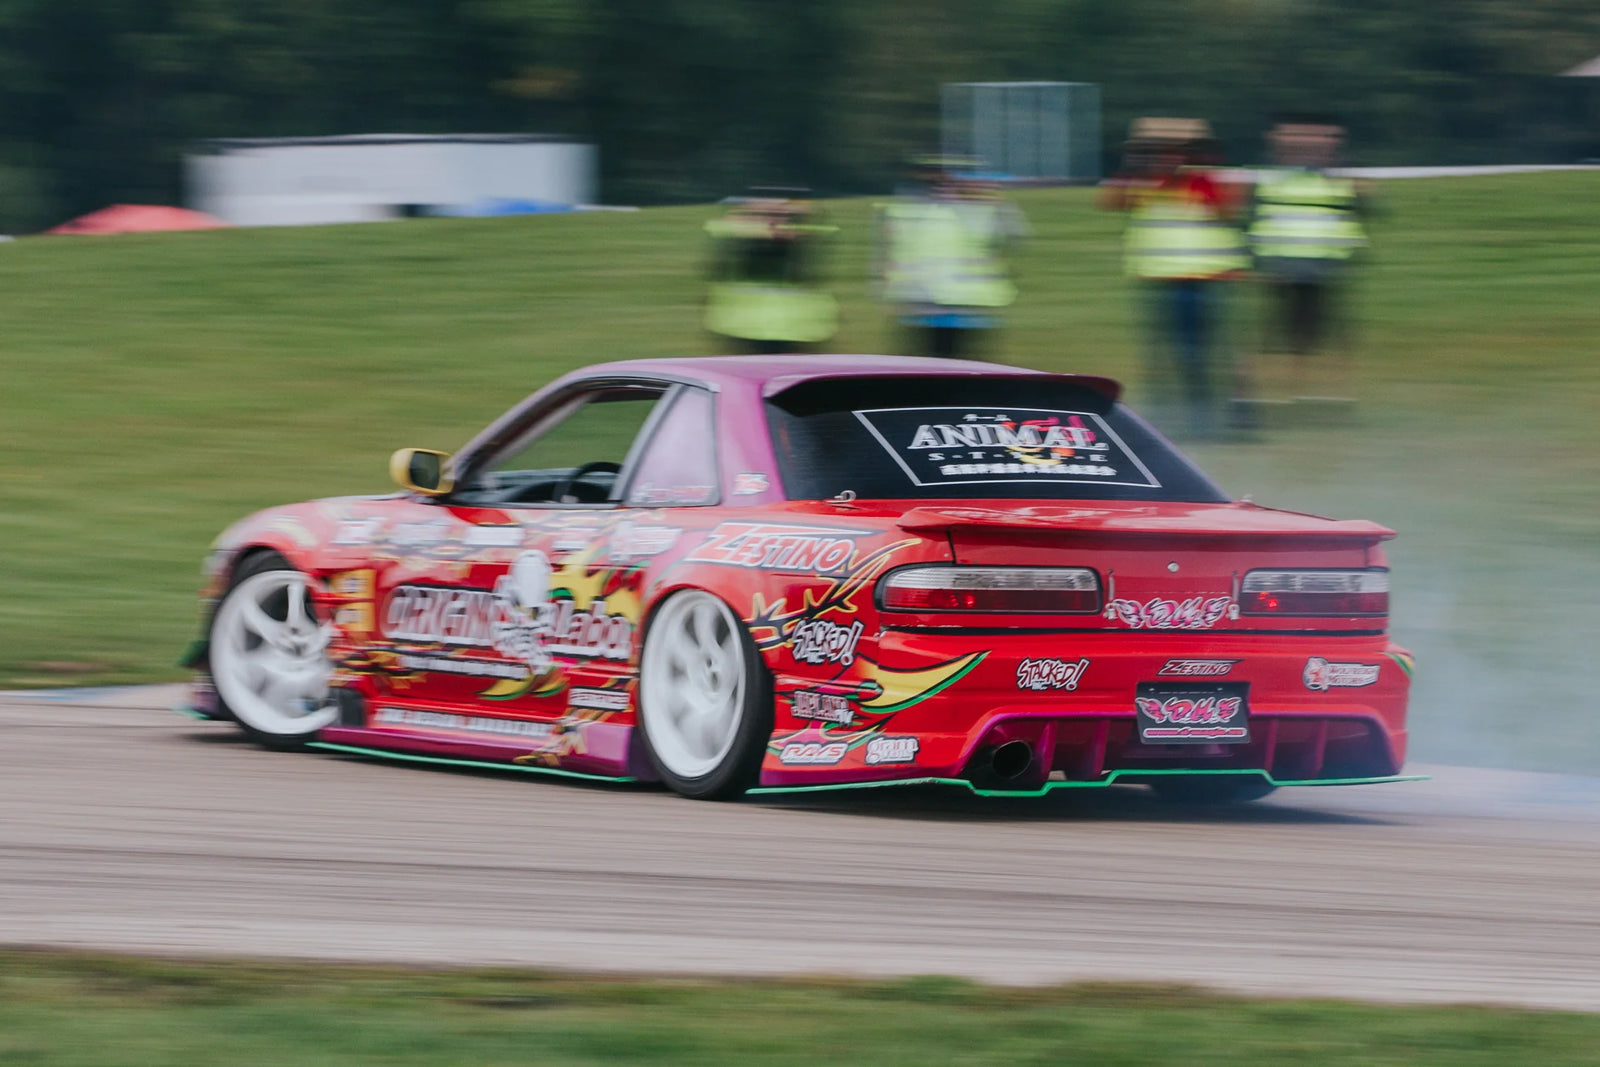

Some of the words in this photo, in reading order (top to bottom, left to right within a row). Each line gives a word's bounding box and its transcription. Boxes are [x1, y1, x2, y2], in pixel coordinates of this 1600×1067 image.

[683, 522, 868, 572] ZESTINO
[1016, 658, 1090, 691] STACKED!
[1157, 659, 1240, 676] ZESTINO
